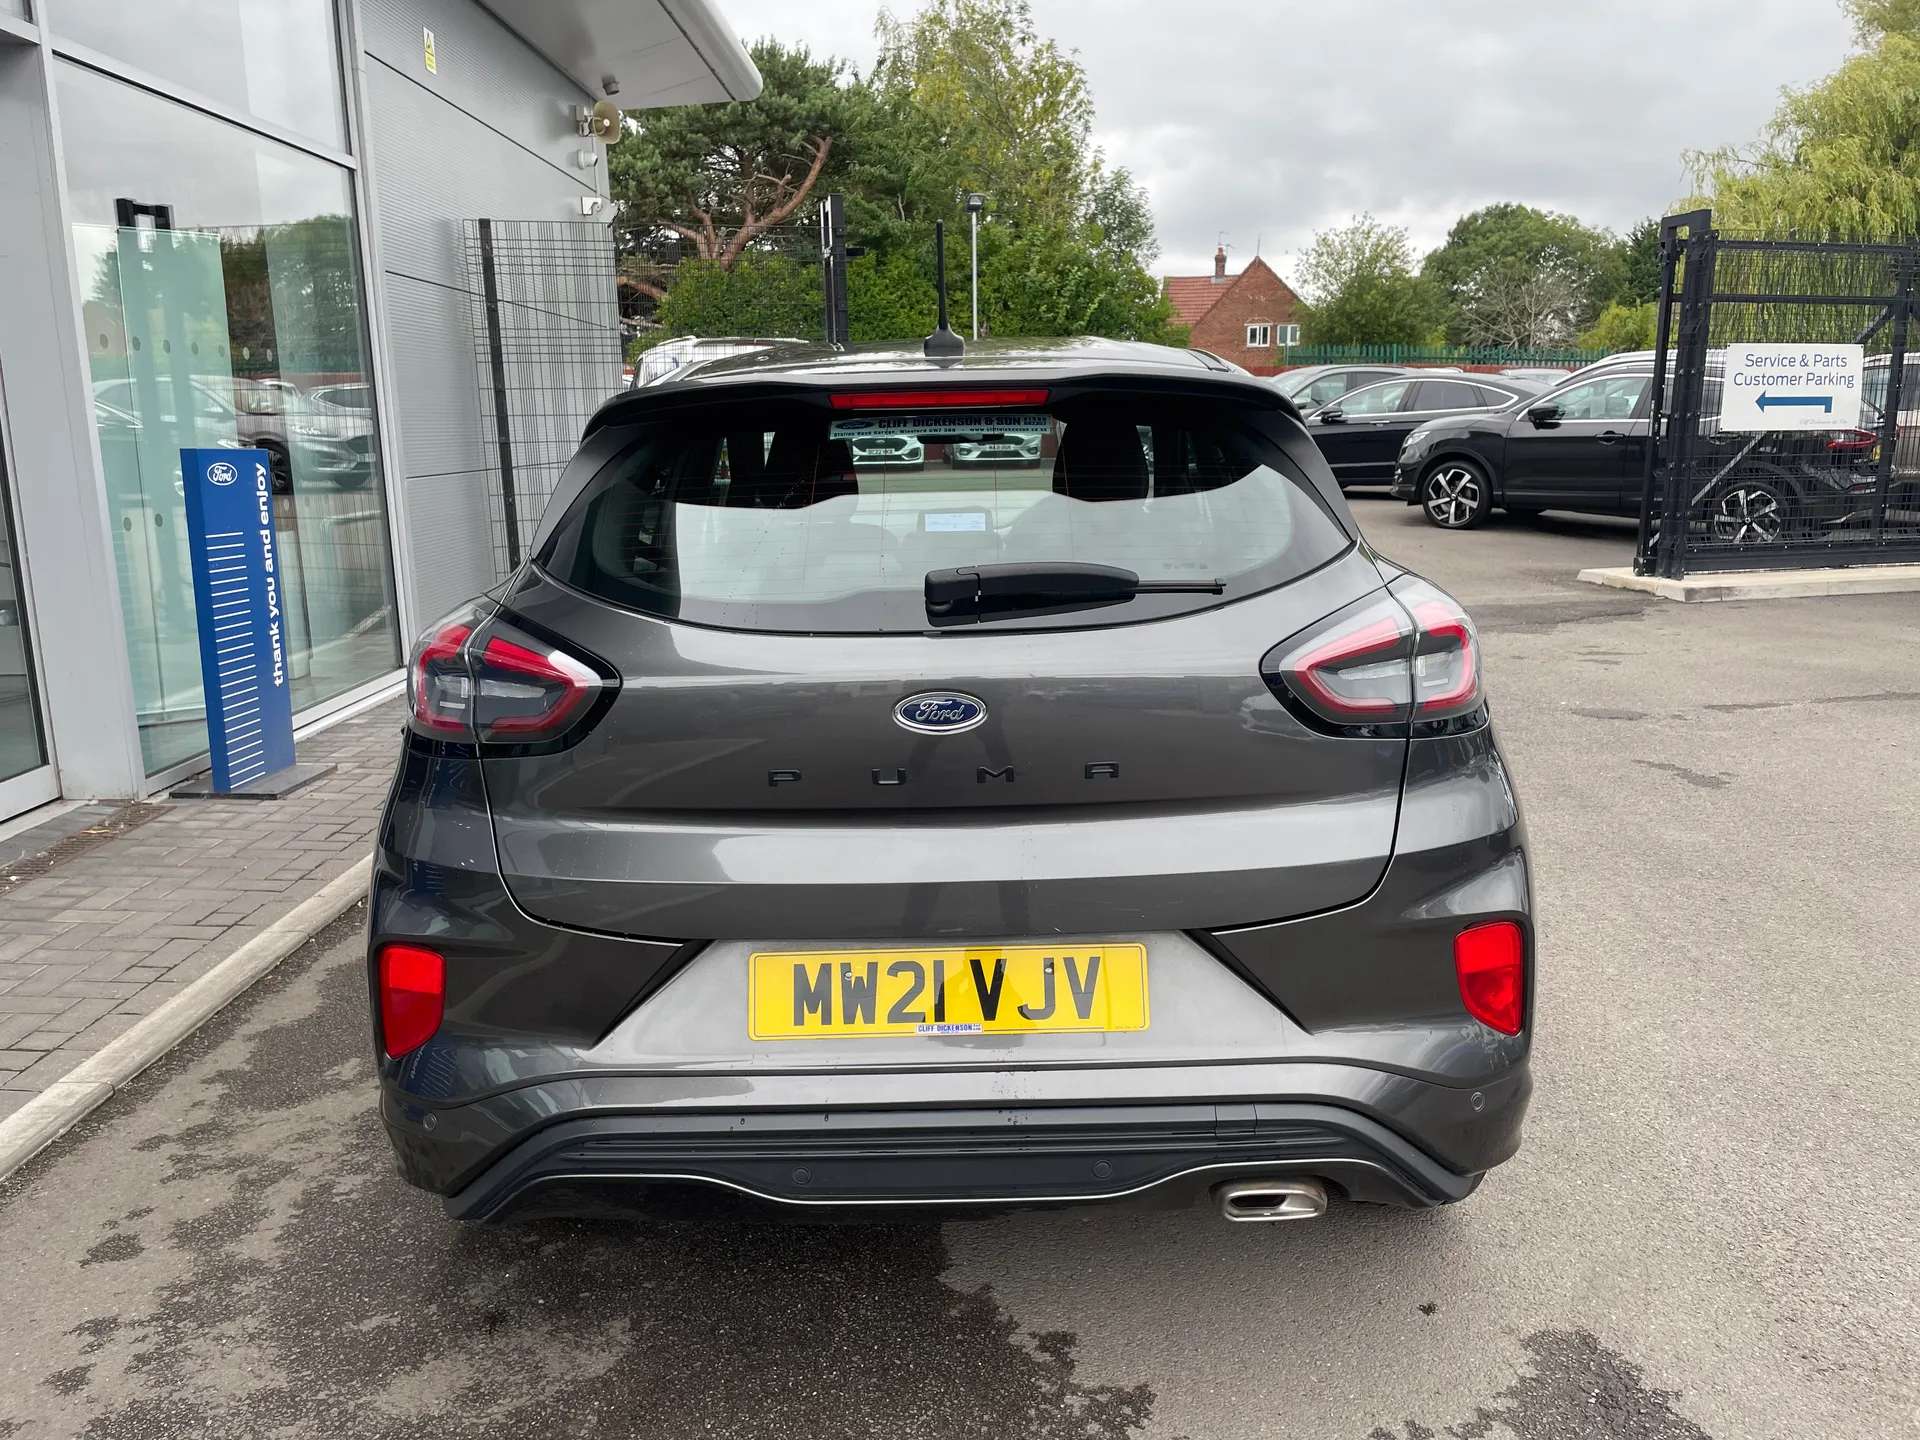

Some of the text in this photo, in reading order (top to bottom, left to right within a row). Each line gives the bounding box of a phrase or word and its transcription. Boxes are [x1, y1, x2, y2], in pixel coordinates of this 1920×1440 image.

[1745, 353, 1847, 367] Service & Parts
[1734, 372, 1854, 388] Customer Parking
[878, 418, 908, 428] CLIFF
[912, 416, 982, 427] DICKENSON
[996, 416, 1022, 425] SON
[211, 464, 234, 482] Ford
[255, 463, 284, 688] thank you and enjoy
[768, 761, 1120, 787] PUMA
[793, 956, 1101, 1026] MW21 VJV
[918, 1024, 934, 1032] CLIFF
[937, 1024, 973, 1032] DICKENSON
